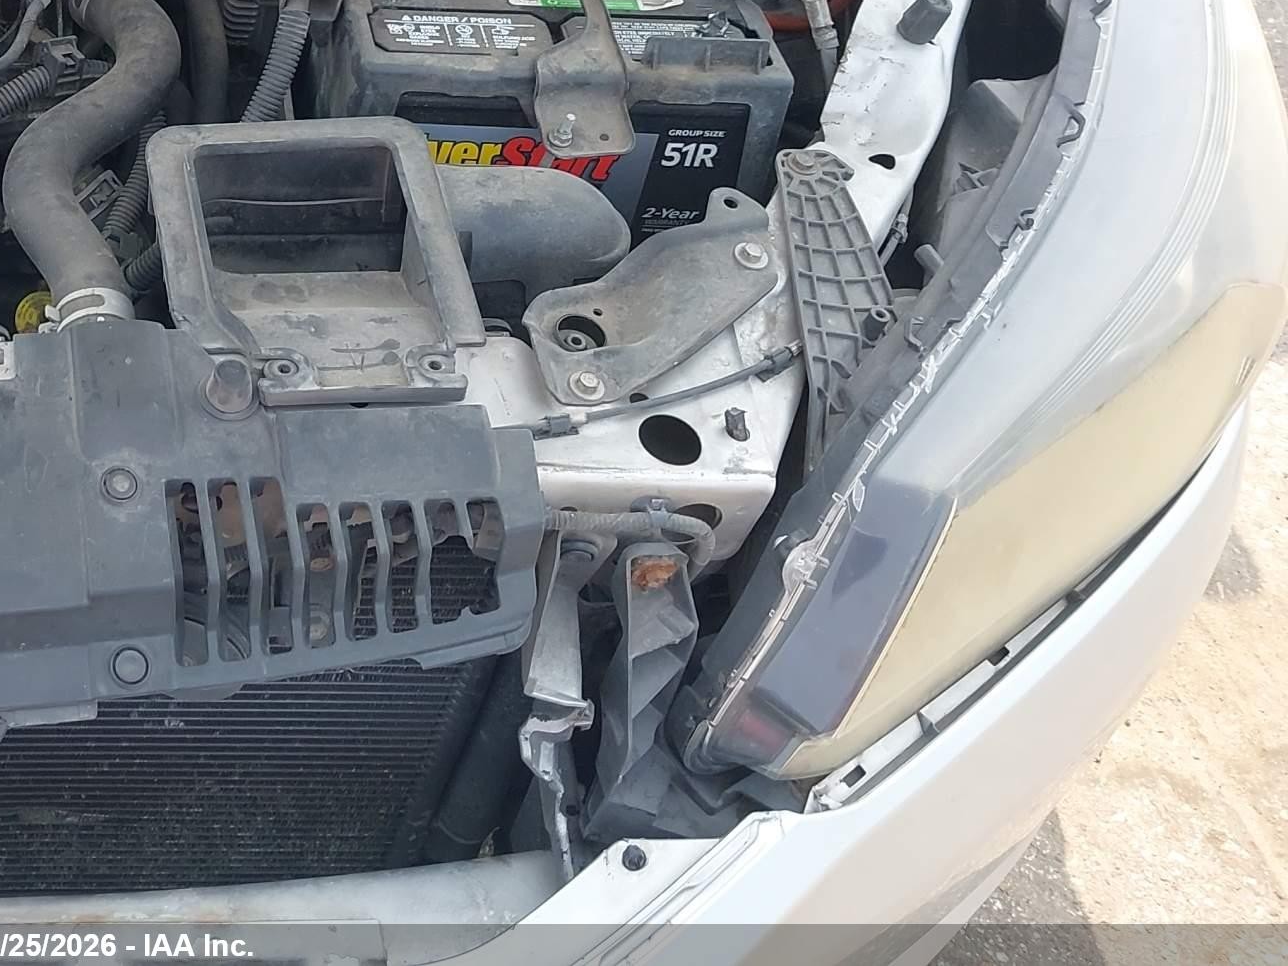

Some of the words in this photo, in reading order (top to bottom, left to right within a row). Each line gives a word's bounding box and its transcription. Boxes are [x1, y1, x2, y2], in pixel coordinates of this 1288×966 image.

[413, 15, 459, 23] DANGER
[470, 17, 512, 25] POISON
[668, 129, 703, 137] GROUP
[703, 130, 727, 138] SIZE
[661, 142, 718, 168] 51R
[641, 207, 700, 220] 2-Year
